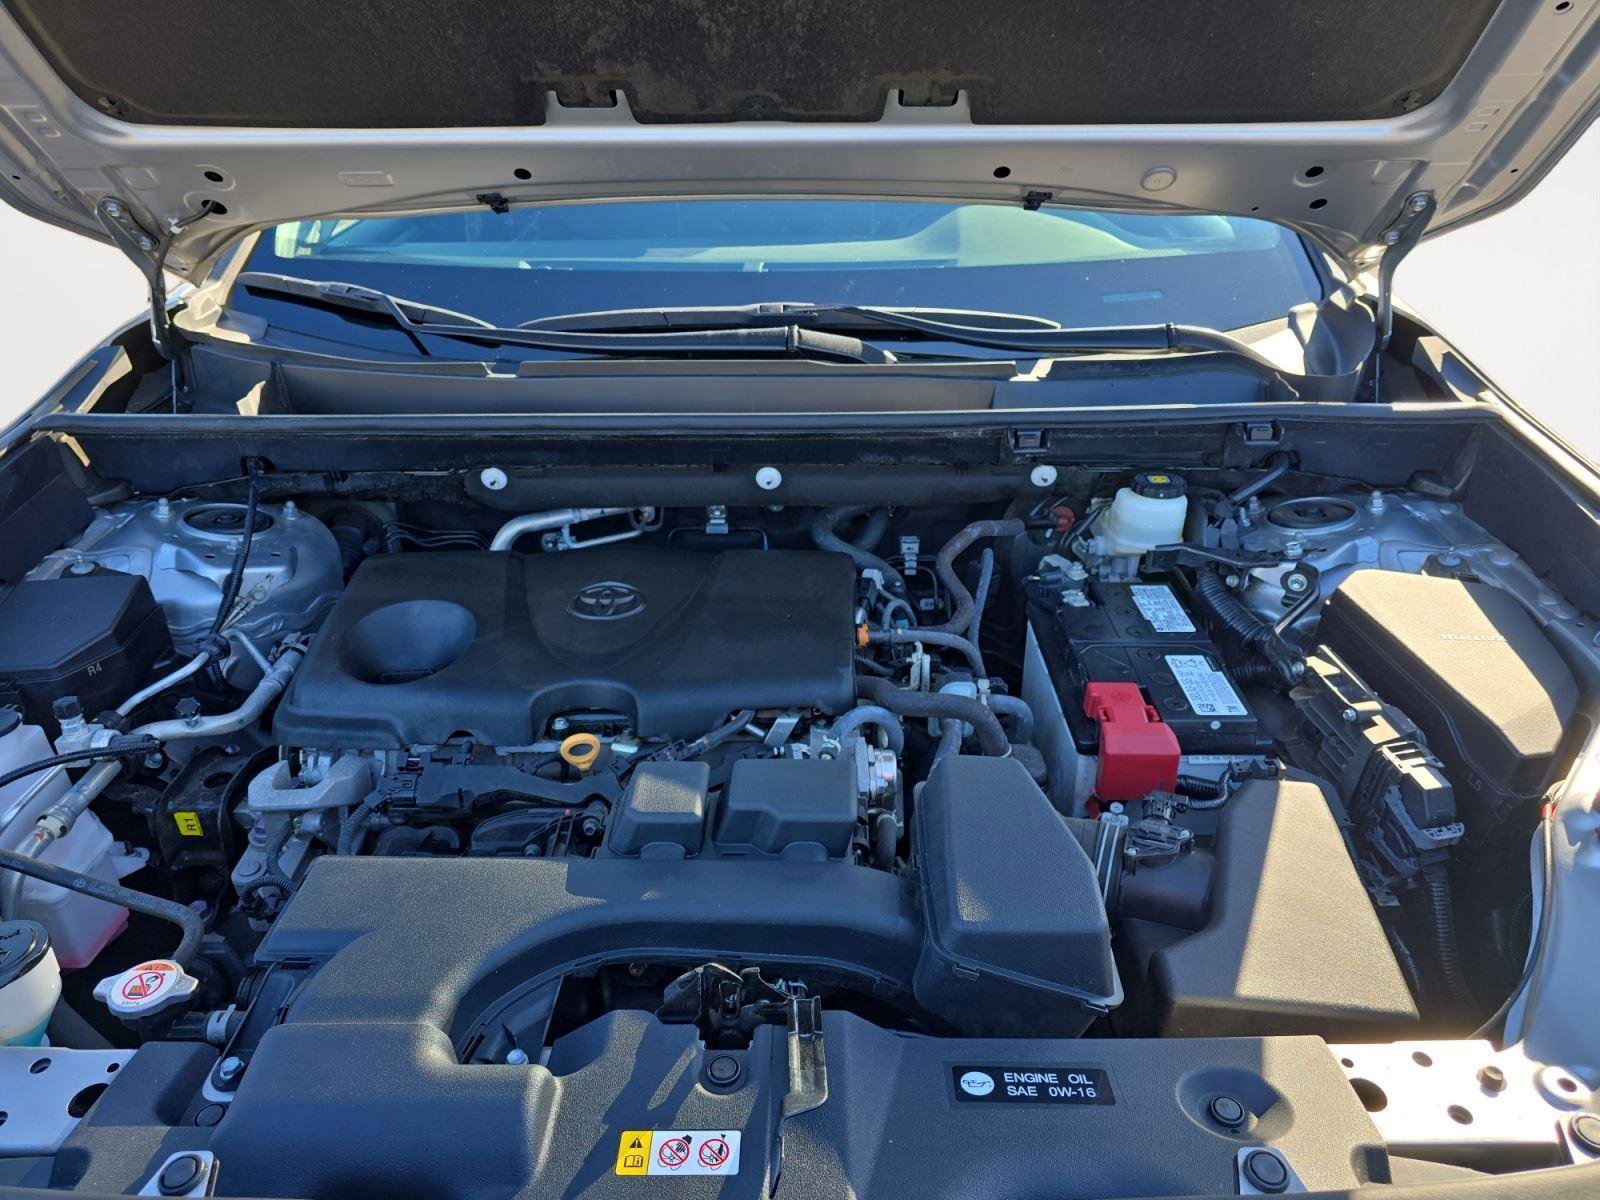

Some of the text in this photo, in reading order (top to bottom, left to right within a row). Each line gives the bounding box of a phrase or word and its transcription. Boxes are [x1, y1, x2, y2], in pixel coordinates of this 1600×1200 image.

[87, 662, 103, 676] R4
[1004, 1072, 1093, 1085] ENGINE OIL
[1007, 1086, 1097, 1098] SAE 0W-16
